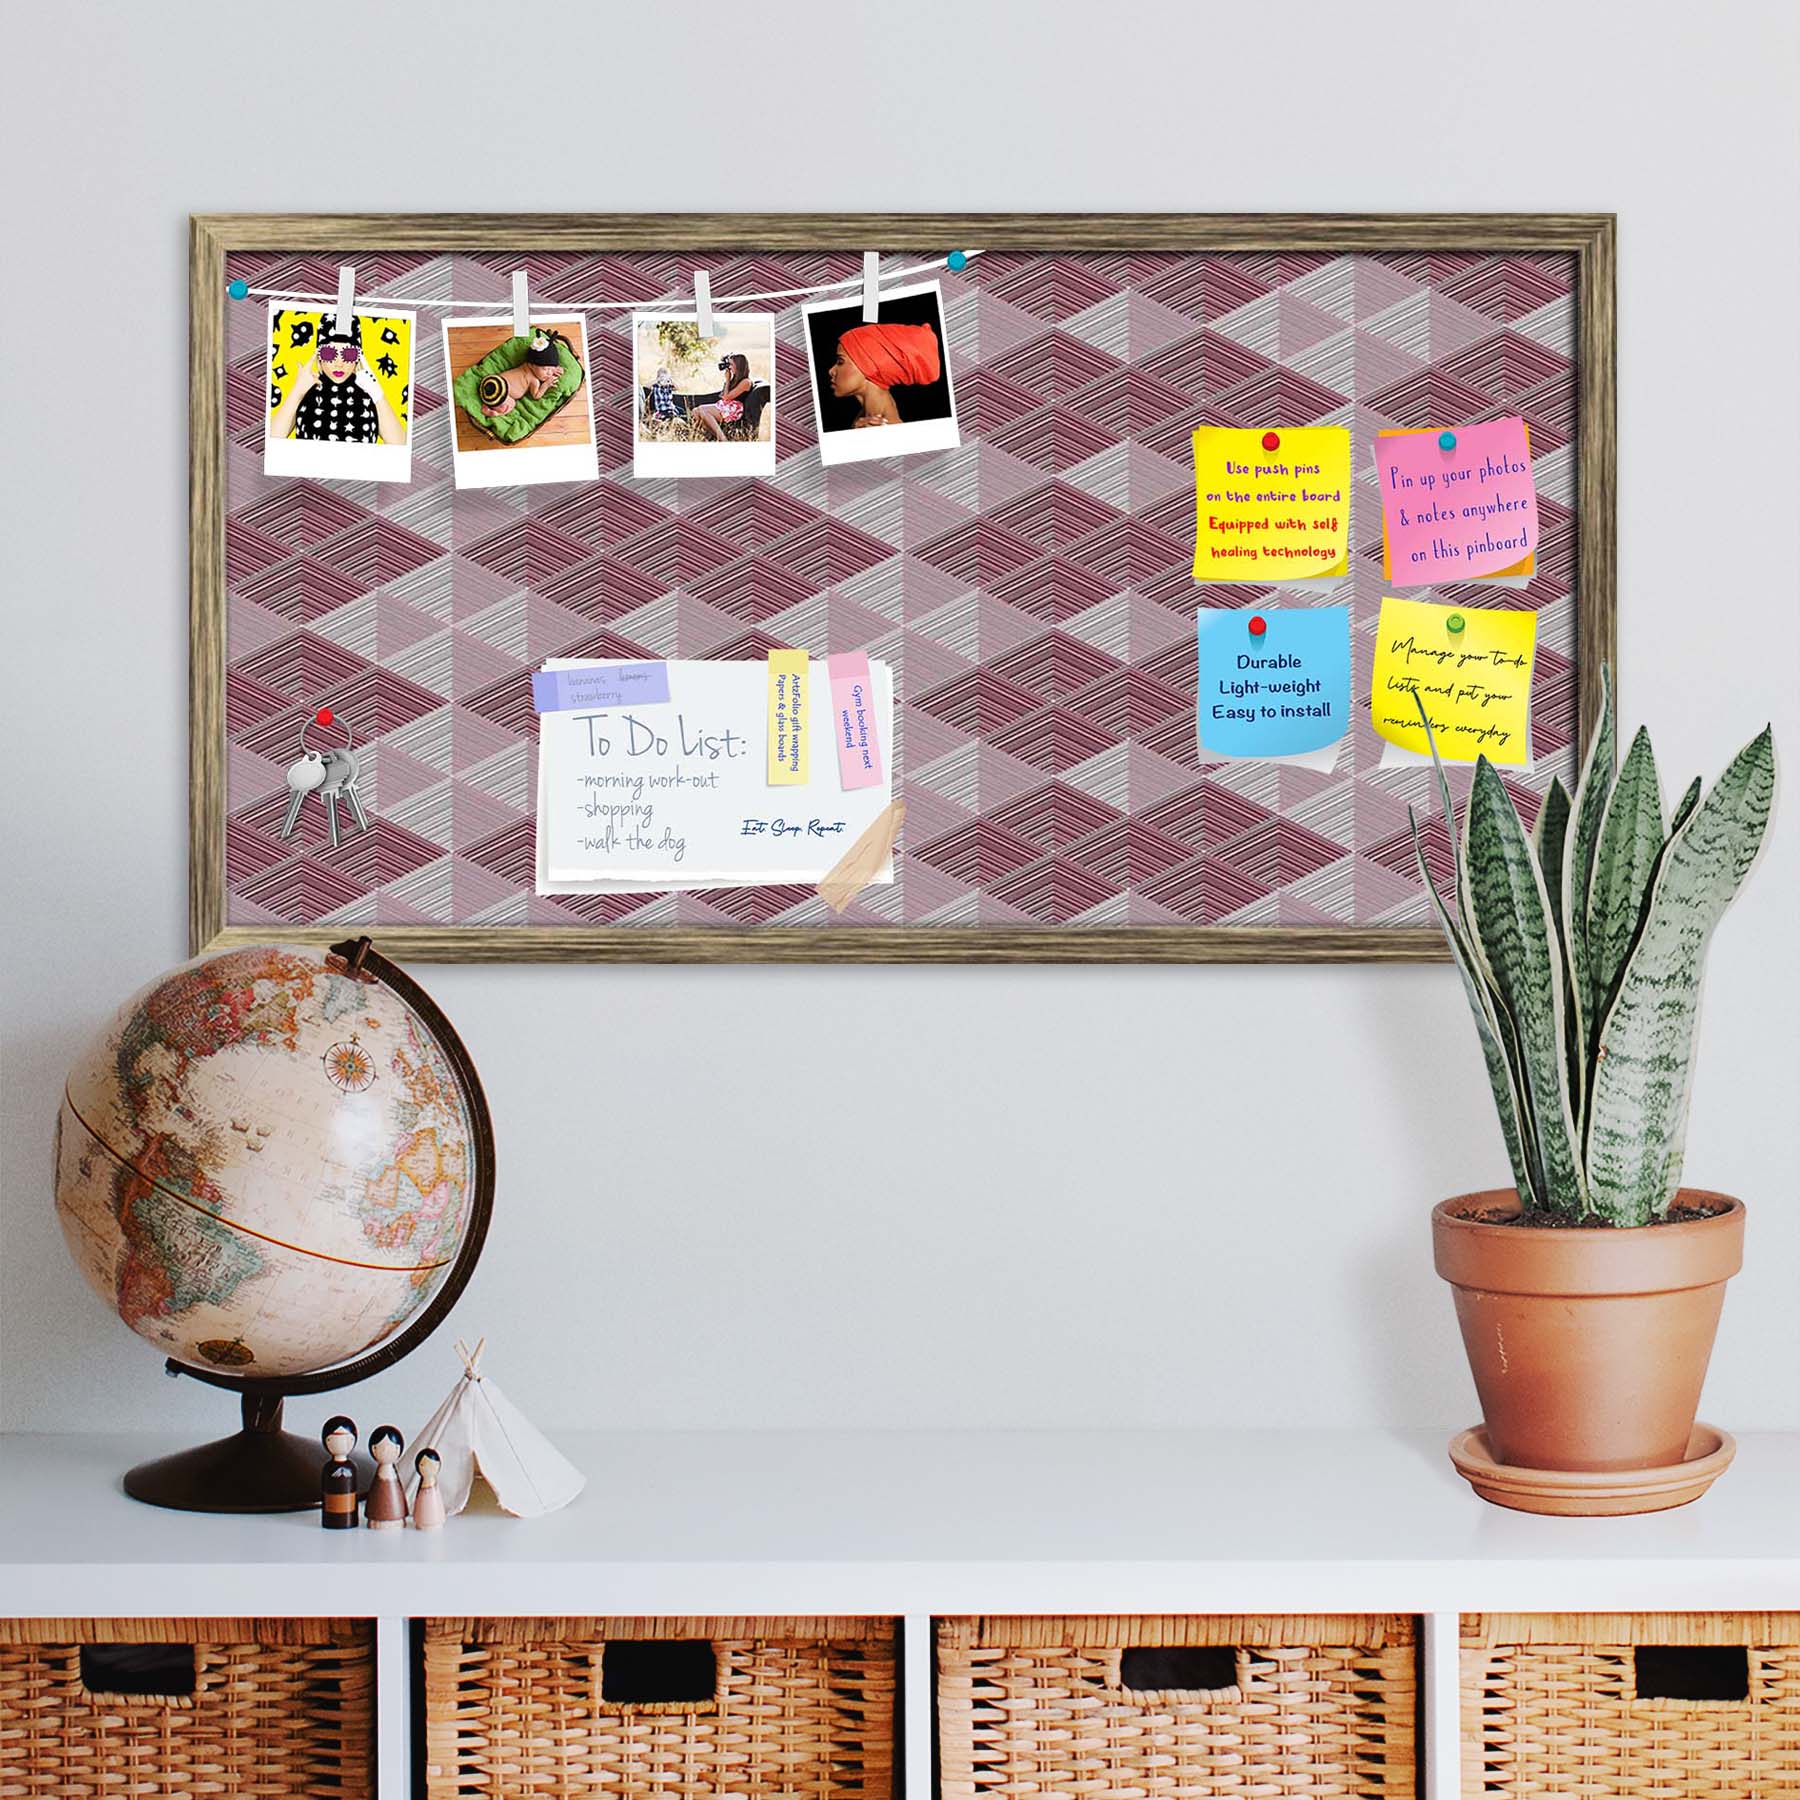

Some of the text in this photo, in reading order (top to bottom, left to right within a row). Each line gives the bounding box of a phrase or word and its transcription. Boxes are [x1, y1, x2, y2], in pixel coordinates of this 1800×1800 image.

[1226, 461, 1320, 478] Use push pins
[1390, 455, 1526, 490] Pin up your photos
[1206, 489, 1341, 502] on the entire board
[1400, 493, 1528, 526] & notes anywhere
[1208, 516, 1339, 534] Equipped with self
[1211, 546, 1336, 560] healing technology
[1411, 528, 1528, 562] on this pinboard
[1237, 654, 1302, 670] Durable
[1391, 636, 1455, 665] Manage
[1457, 653, 1488, 668] your
[1219, 678, 1321, 698] Light-weight
[1424, 683, 1455, 699] and
[1456, 685, 1485, 704] put
[1483, 691, 1513, 708] your
[776, 674, 788, 762] Papers & glass boards
[790, 673, 802, 772] ArtzFolio gift wrapping
[1212, 702, 1332, 723] Easy to install
[572, 714, 748, 760] To Do List:
[842, 709, 857, 749] weekend
[852, 685, 873, 769] Gym booking next
[1454, 723, 1512, 746] everyday
[648, 765, 720, 789] work-out
[625, 827, 654, 851] the
[657, 828, 687, 862] dog
